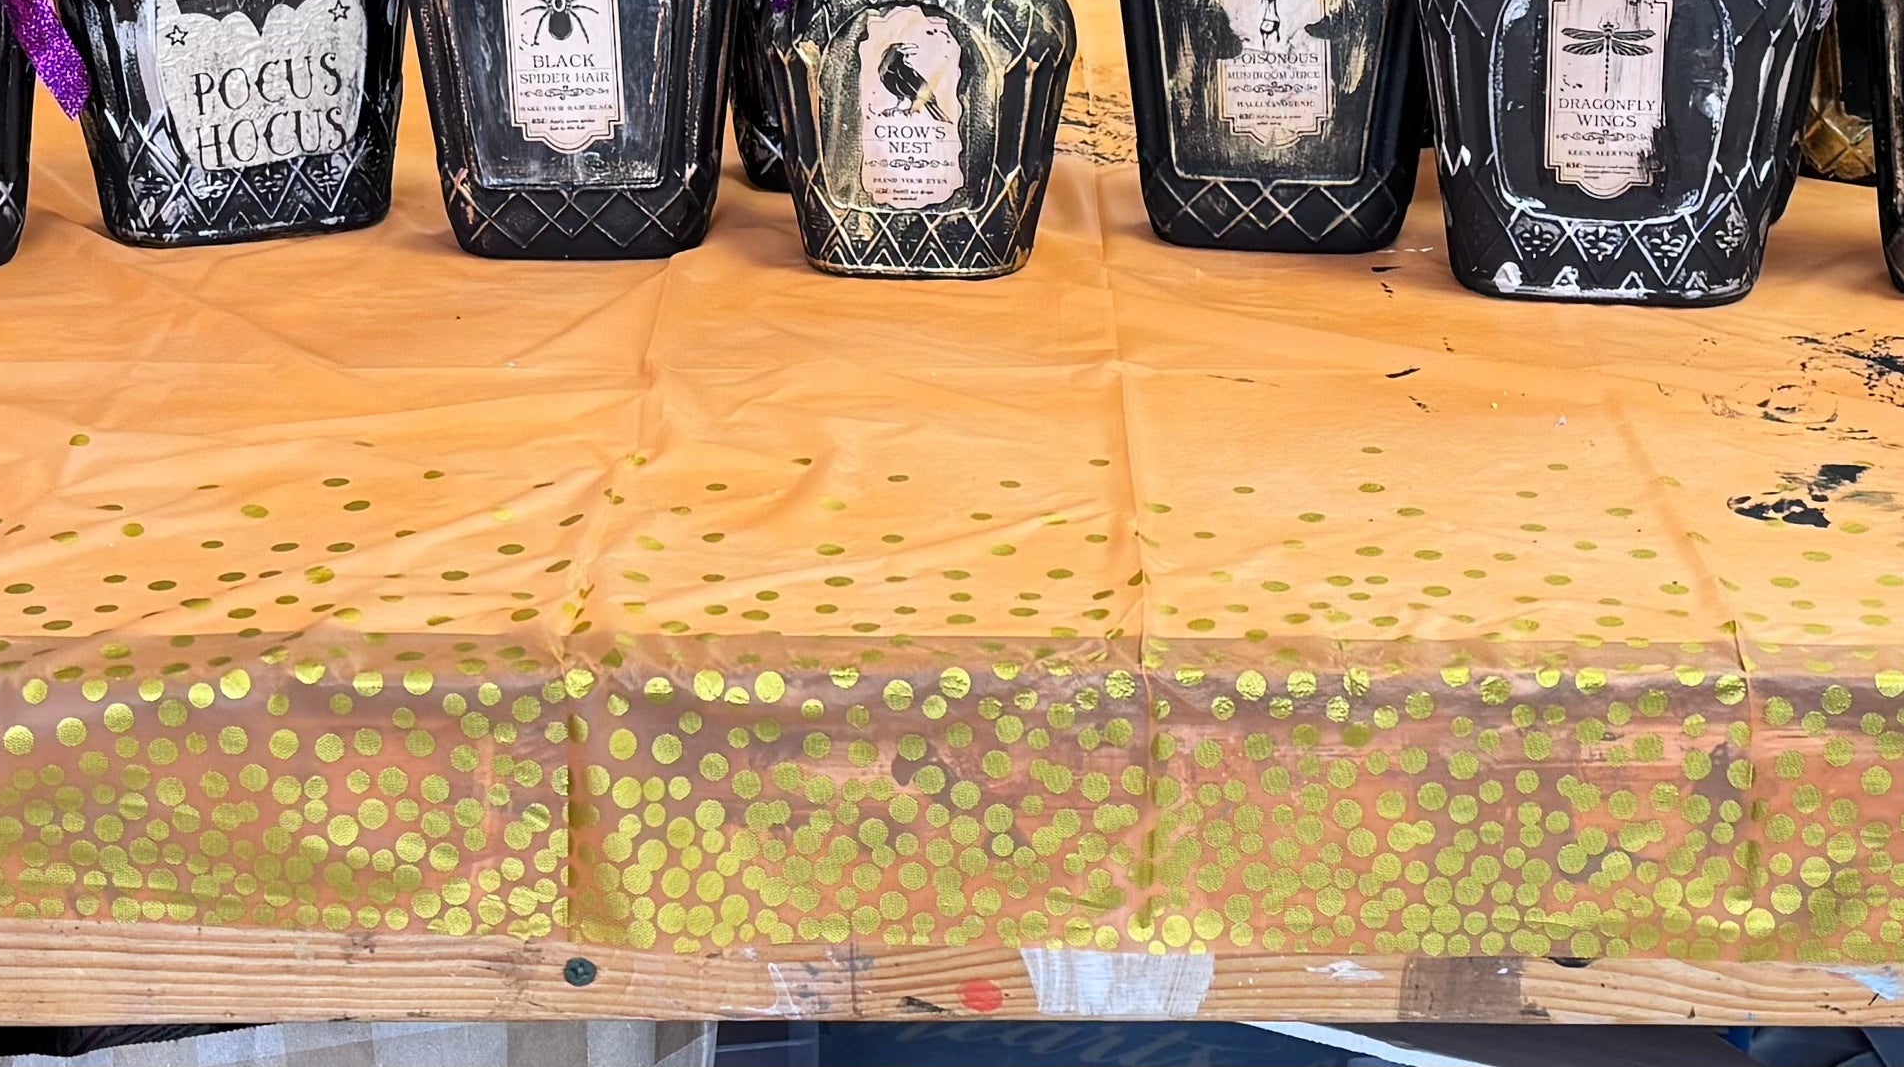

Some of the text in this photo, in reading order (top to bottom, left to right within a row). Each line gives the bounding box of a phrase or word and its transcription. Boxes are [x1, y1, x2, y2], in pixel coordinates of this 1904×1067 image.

[532, 54, 595, 68] BLACK
[192, 52, 341, 115] POCUS
[520, 72, 610, 84] SPIDER HAIR
[1559, 98, 1655, 111] DRAGONFLY
[1577, 114, 1637, 127] WINGS
[196, 107, 346, 168] HOCUS
[874, 125, 946, 139] CROW'S
[889, 141, 932, 153] NEST
